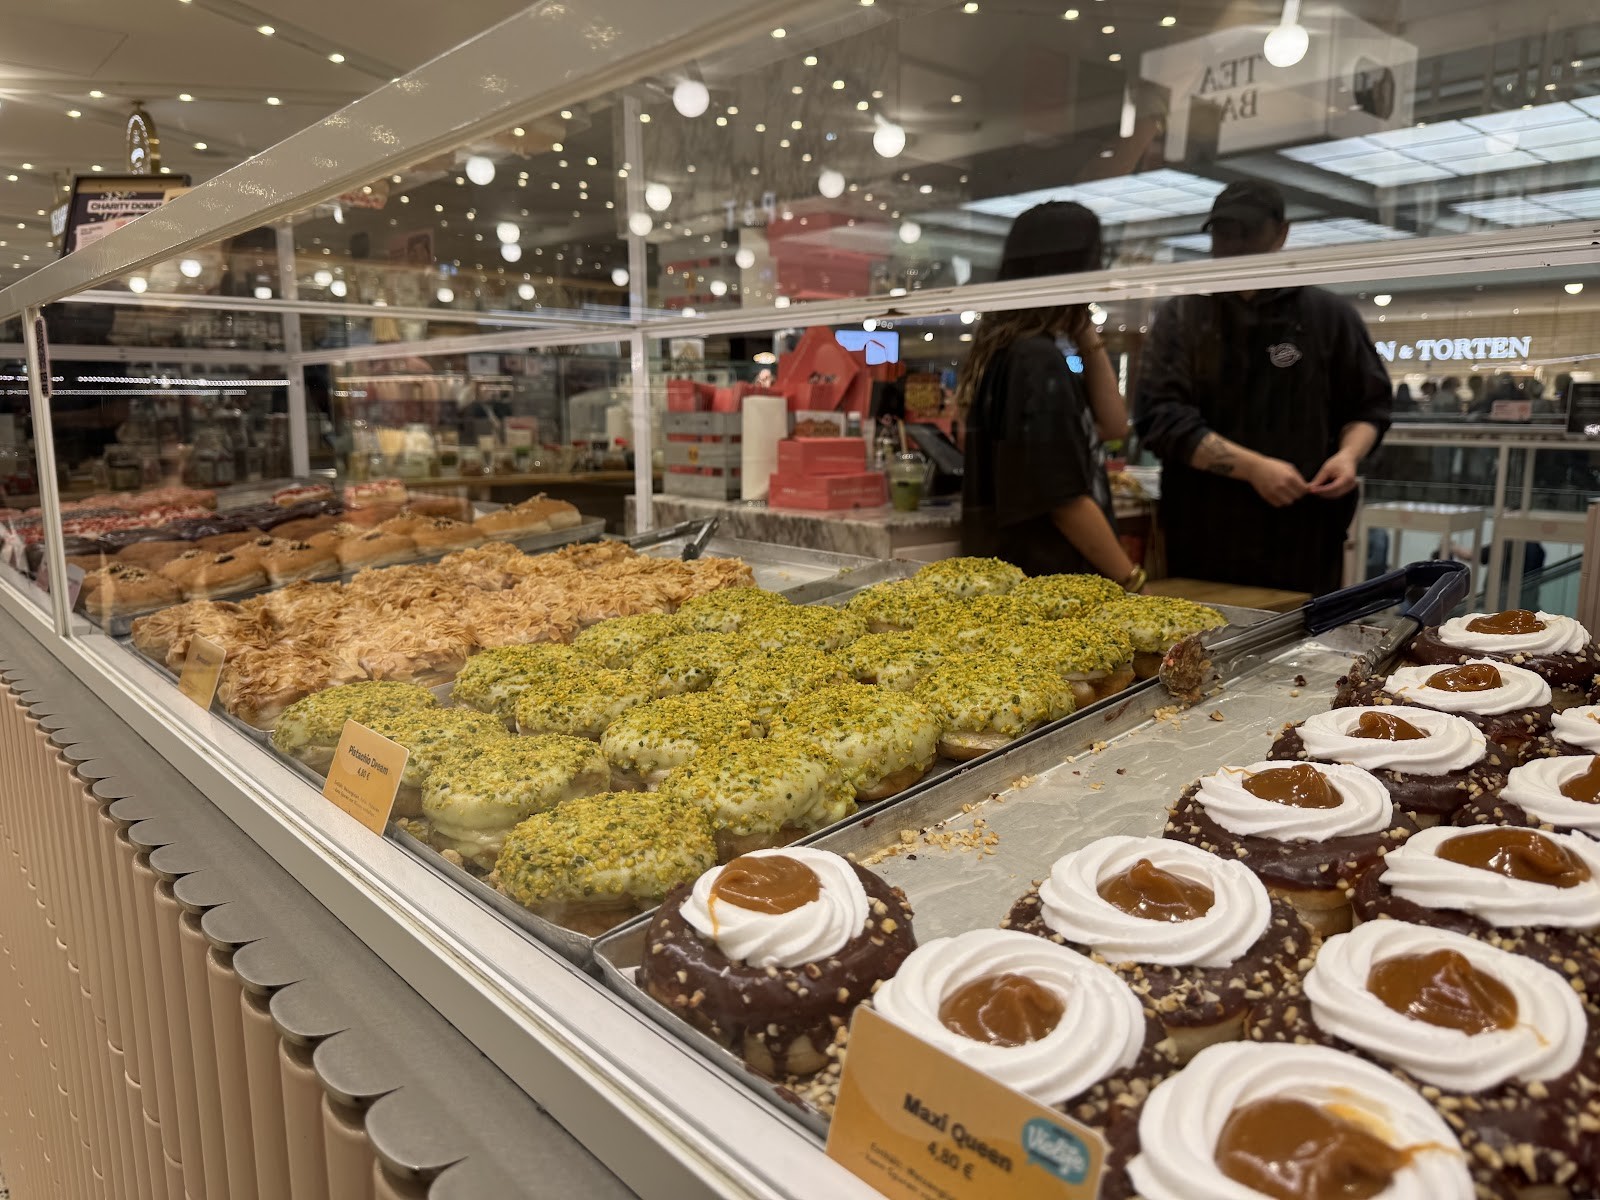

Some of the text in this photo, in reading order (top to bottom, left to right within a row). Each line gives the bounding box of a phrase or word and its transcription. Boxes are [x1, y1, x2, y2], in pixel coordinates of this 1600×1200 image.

[1416, 336, 1532, 361] TORTEN
[349, 745, 389, 776] Pistachio Dream
[903, 1093, 949, 1133] Maxi
[951, 1123, 1013, 1174] Queen
[927, 1141, 960, 1171] 4,80
[963, 1163, 975, 1181] €
